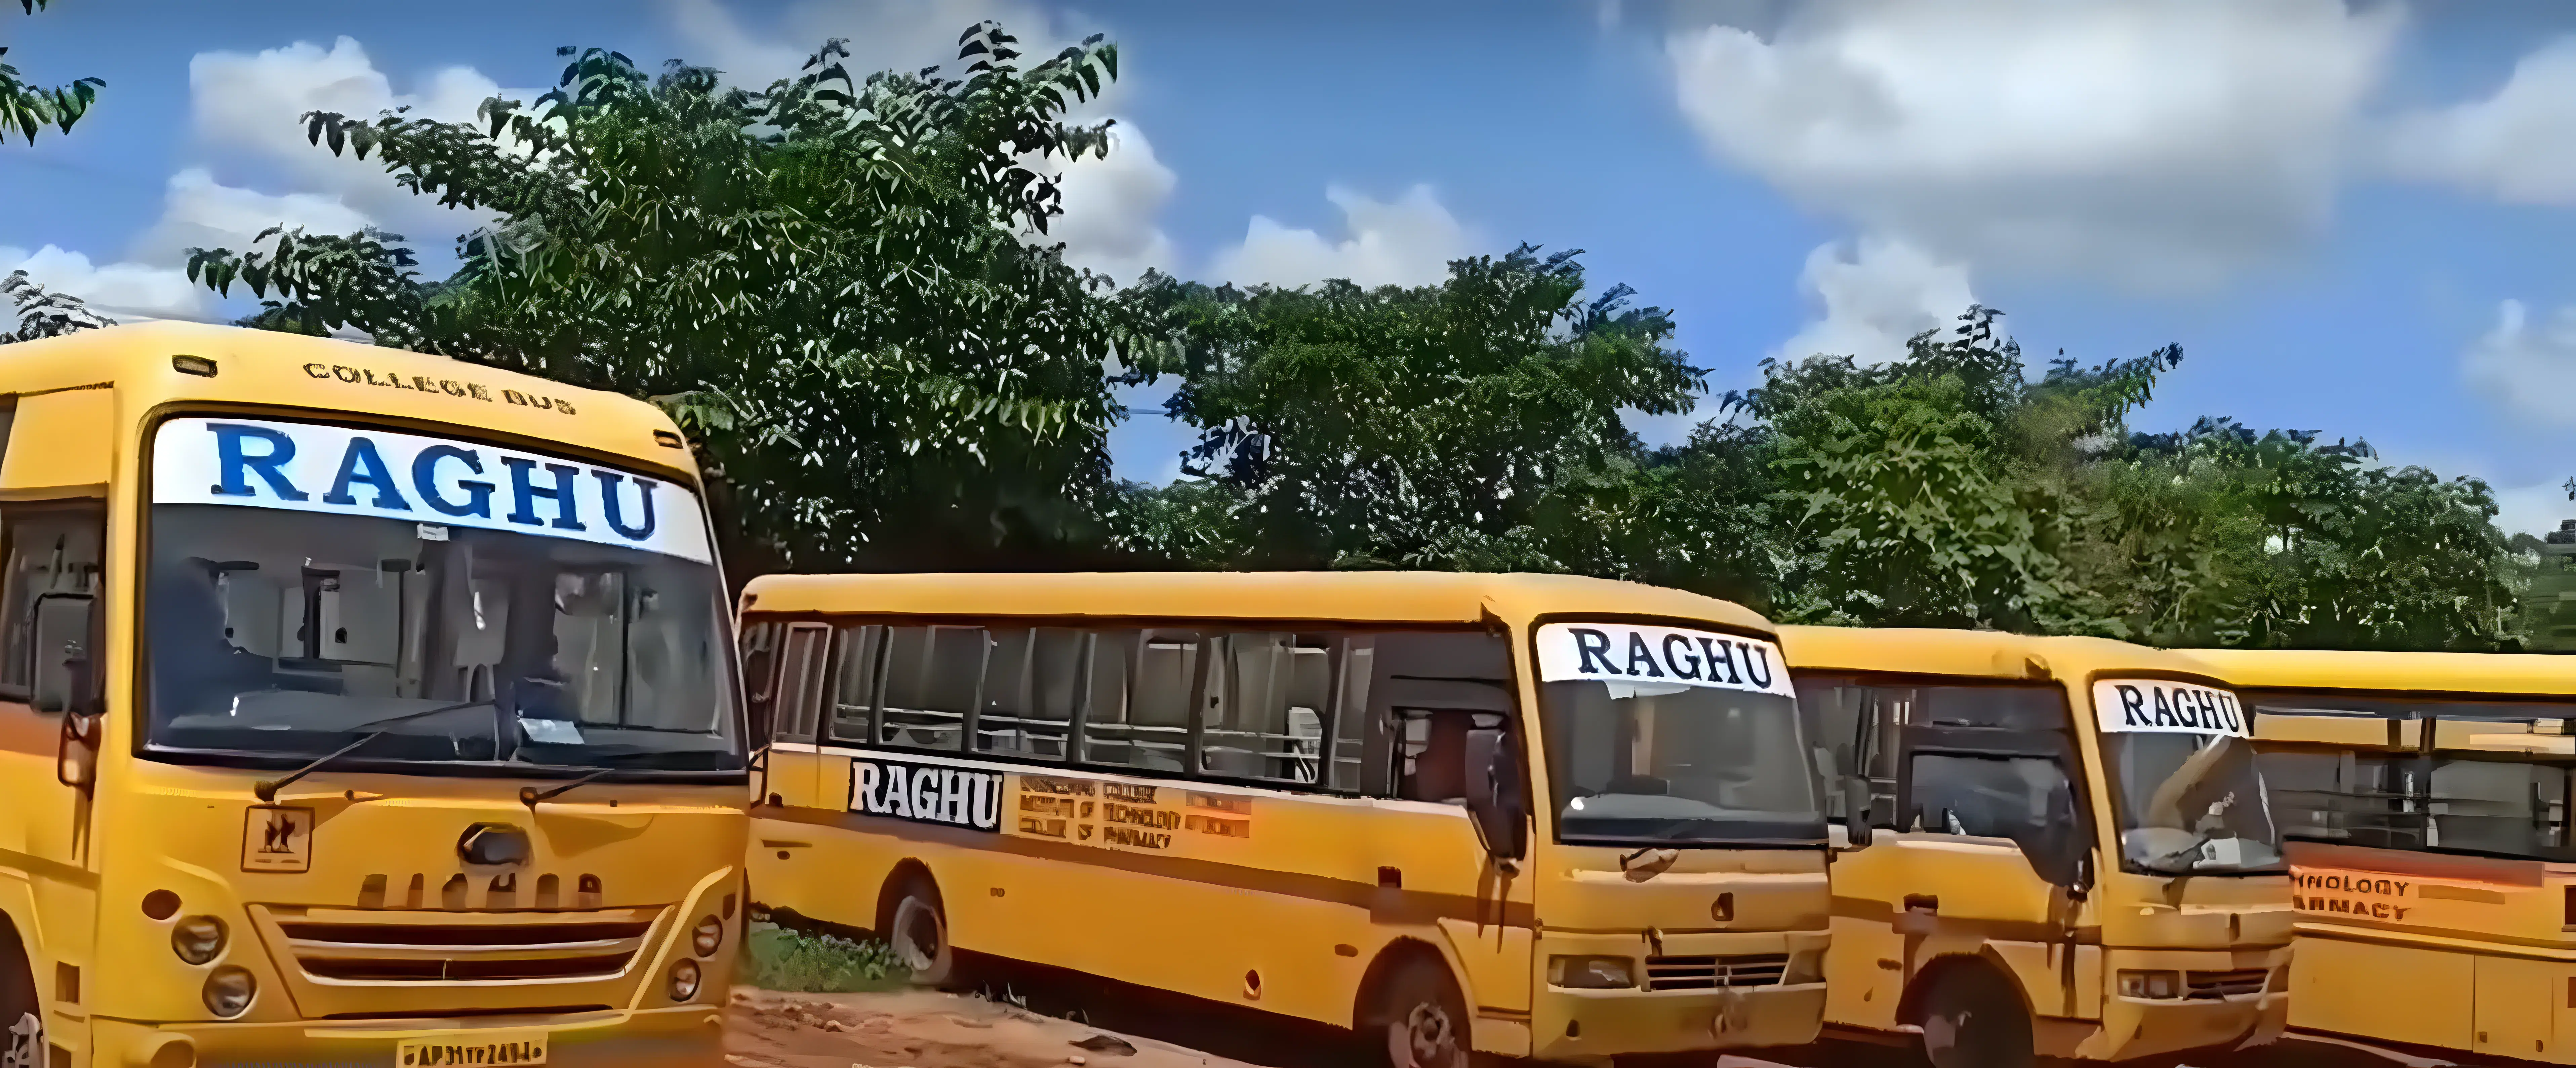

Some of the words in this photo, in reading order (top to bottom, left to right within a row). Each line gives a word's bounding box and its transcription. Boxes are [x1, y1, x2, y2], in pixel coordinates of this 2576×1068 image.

[303, 363, 493, 402] COLLEGE
[501, 389, 576, 415] BUS
[206, 422, 659, 541] RAGHU
[1567, 627, 1772, 689] RAGHU
[2115, 685, 2239, 732] RAGHU
[850, 762, 1003, 829] RAGHU
